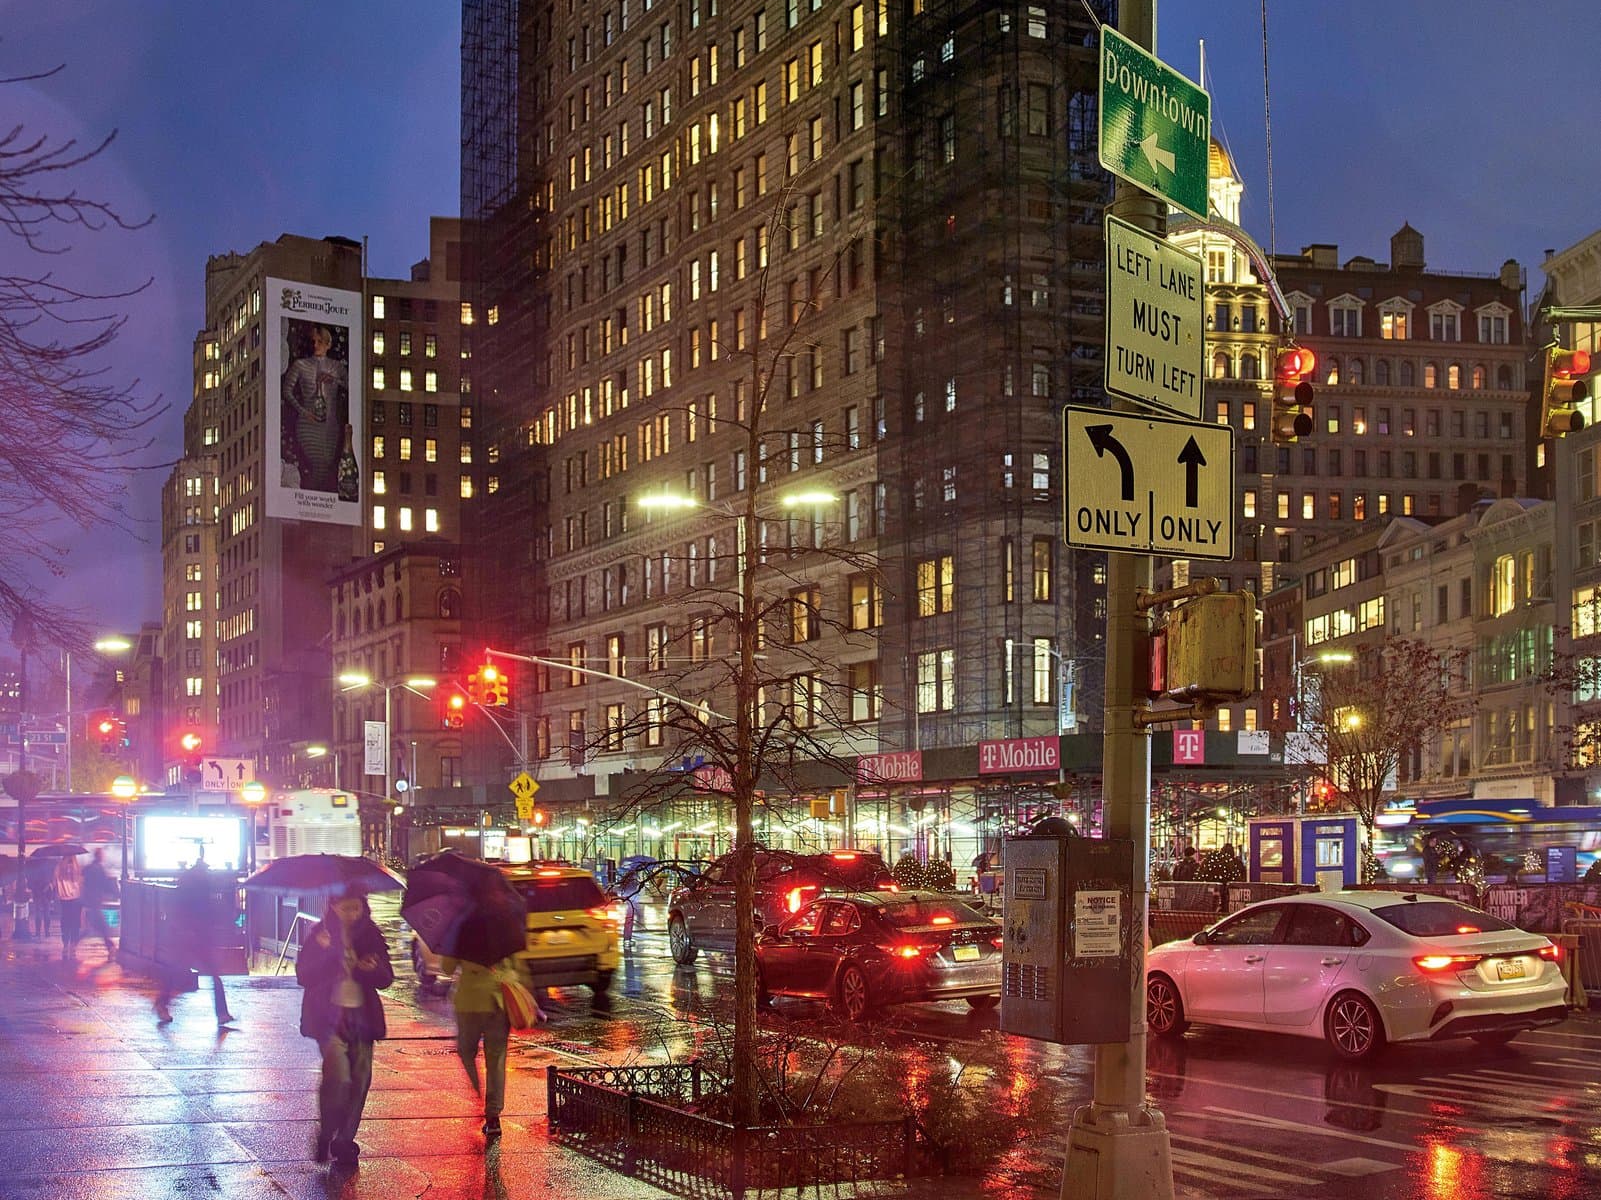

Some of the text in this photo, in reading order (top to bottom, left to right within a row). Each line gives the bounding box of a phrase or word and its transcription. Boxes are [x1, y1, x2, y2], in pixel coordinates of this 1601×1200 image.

[1105, 48, 1206, 141] Downtown
[1117, 244, 1196, 301] LEFT LANE
[1133, 298, 1181, 345] MUST
[1116, 346, 1196, 398] TURN LEFT
[1077, 506, 1142, 537] ONLY
[1160, 515, 1222, 545] ONLY
[983, 741, 1056, 769] T Mobile
[1178, 734, 1199, 760] T
[873, 754, 919, 780] Mobile
[205, 781, 225, 789] ONLY
[1087, 896, 1116, 904] NOTICE
[1489, 890, 1528, 906] WINTER
[1489, 906, 1517, 921] GLOW
